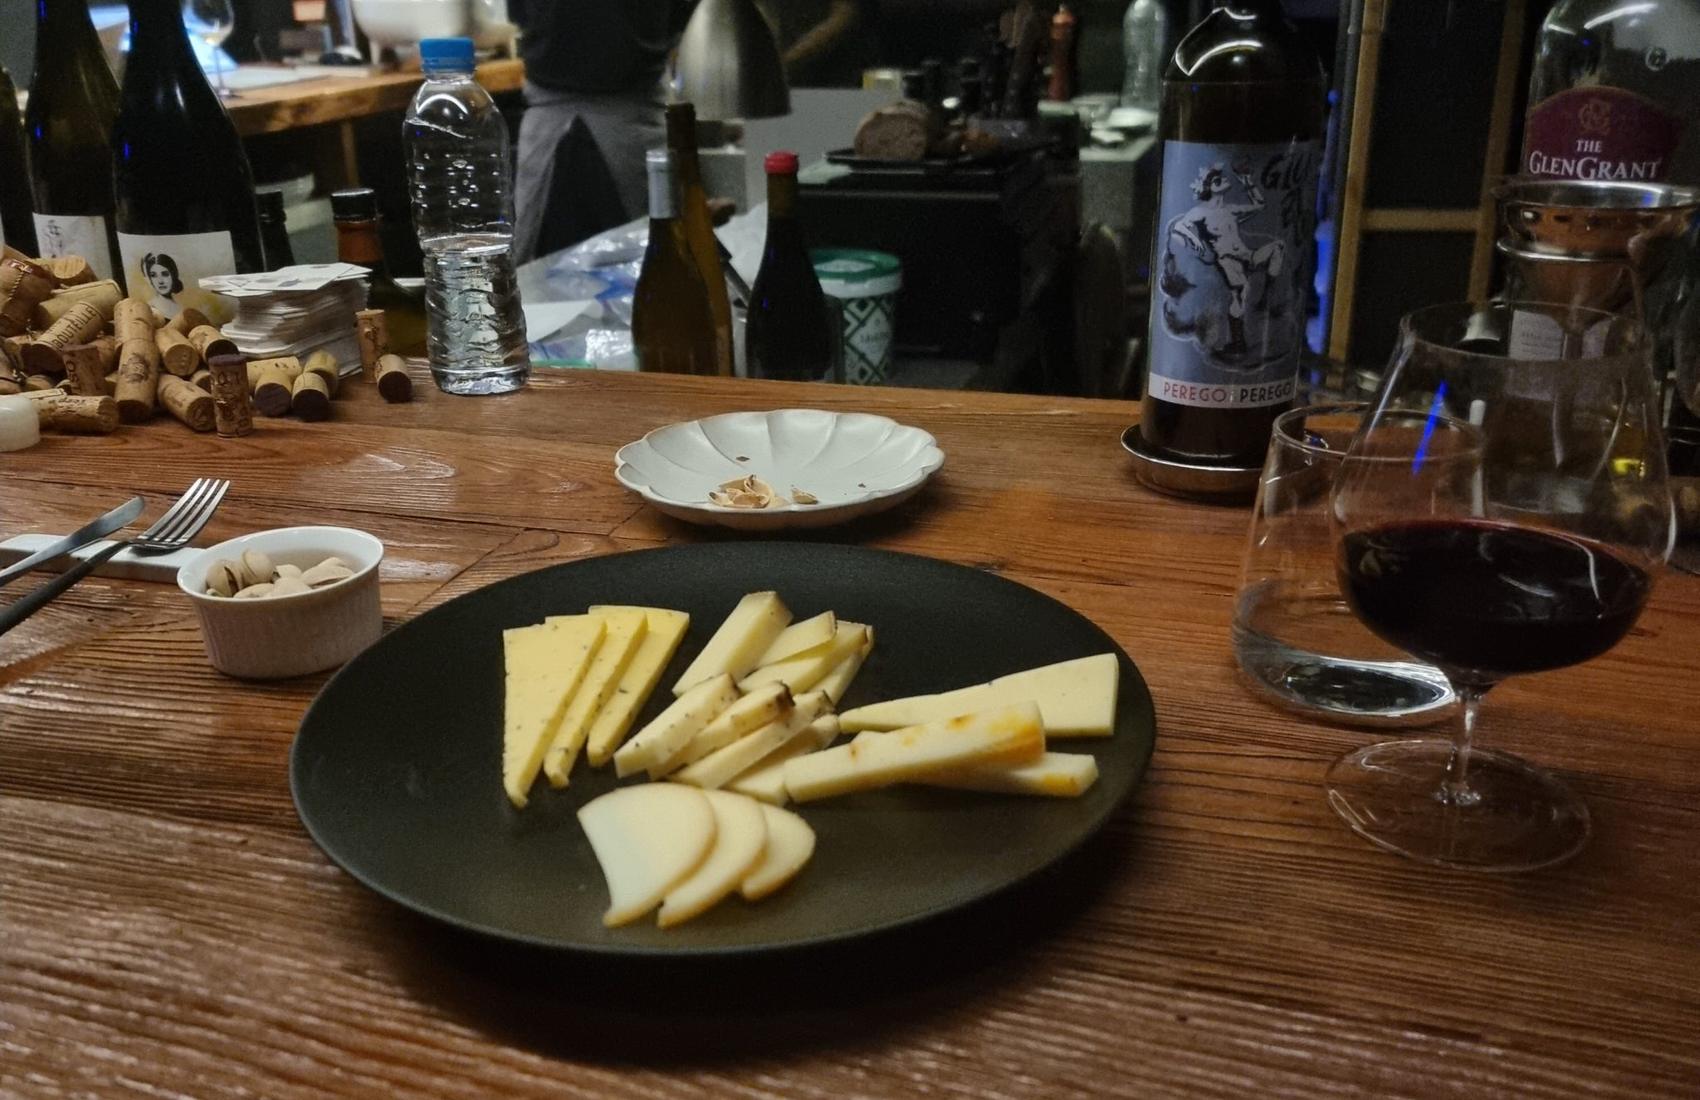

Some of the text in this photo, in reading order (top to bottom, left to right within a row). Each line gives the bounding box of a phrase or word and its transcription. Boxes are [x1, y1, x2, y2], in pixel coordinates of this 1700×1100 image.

[1575, 138, 1603, 153] THE
[52, 306, 97, 349] BOUTEILLE
[1163, 381, 1292, 403] PEREGO PEREGO
